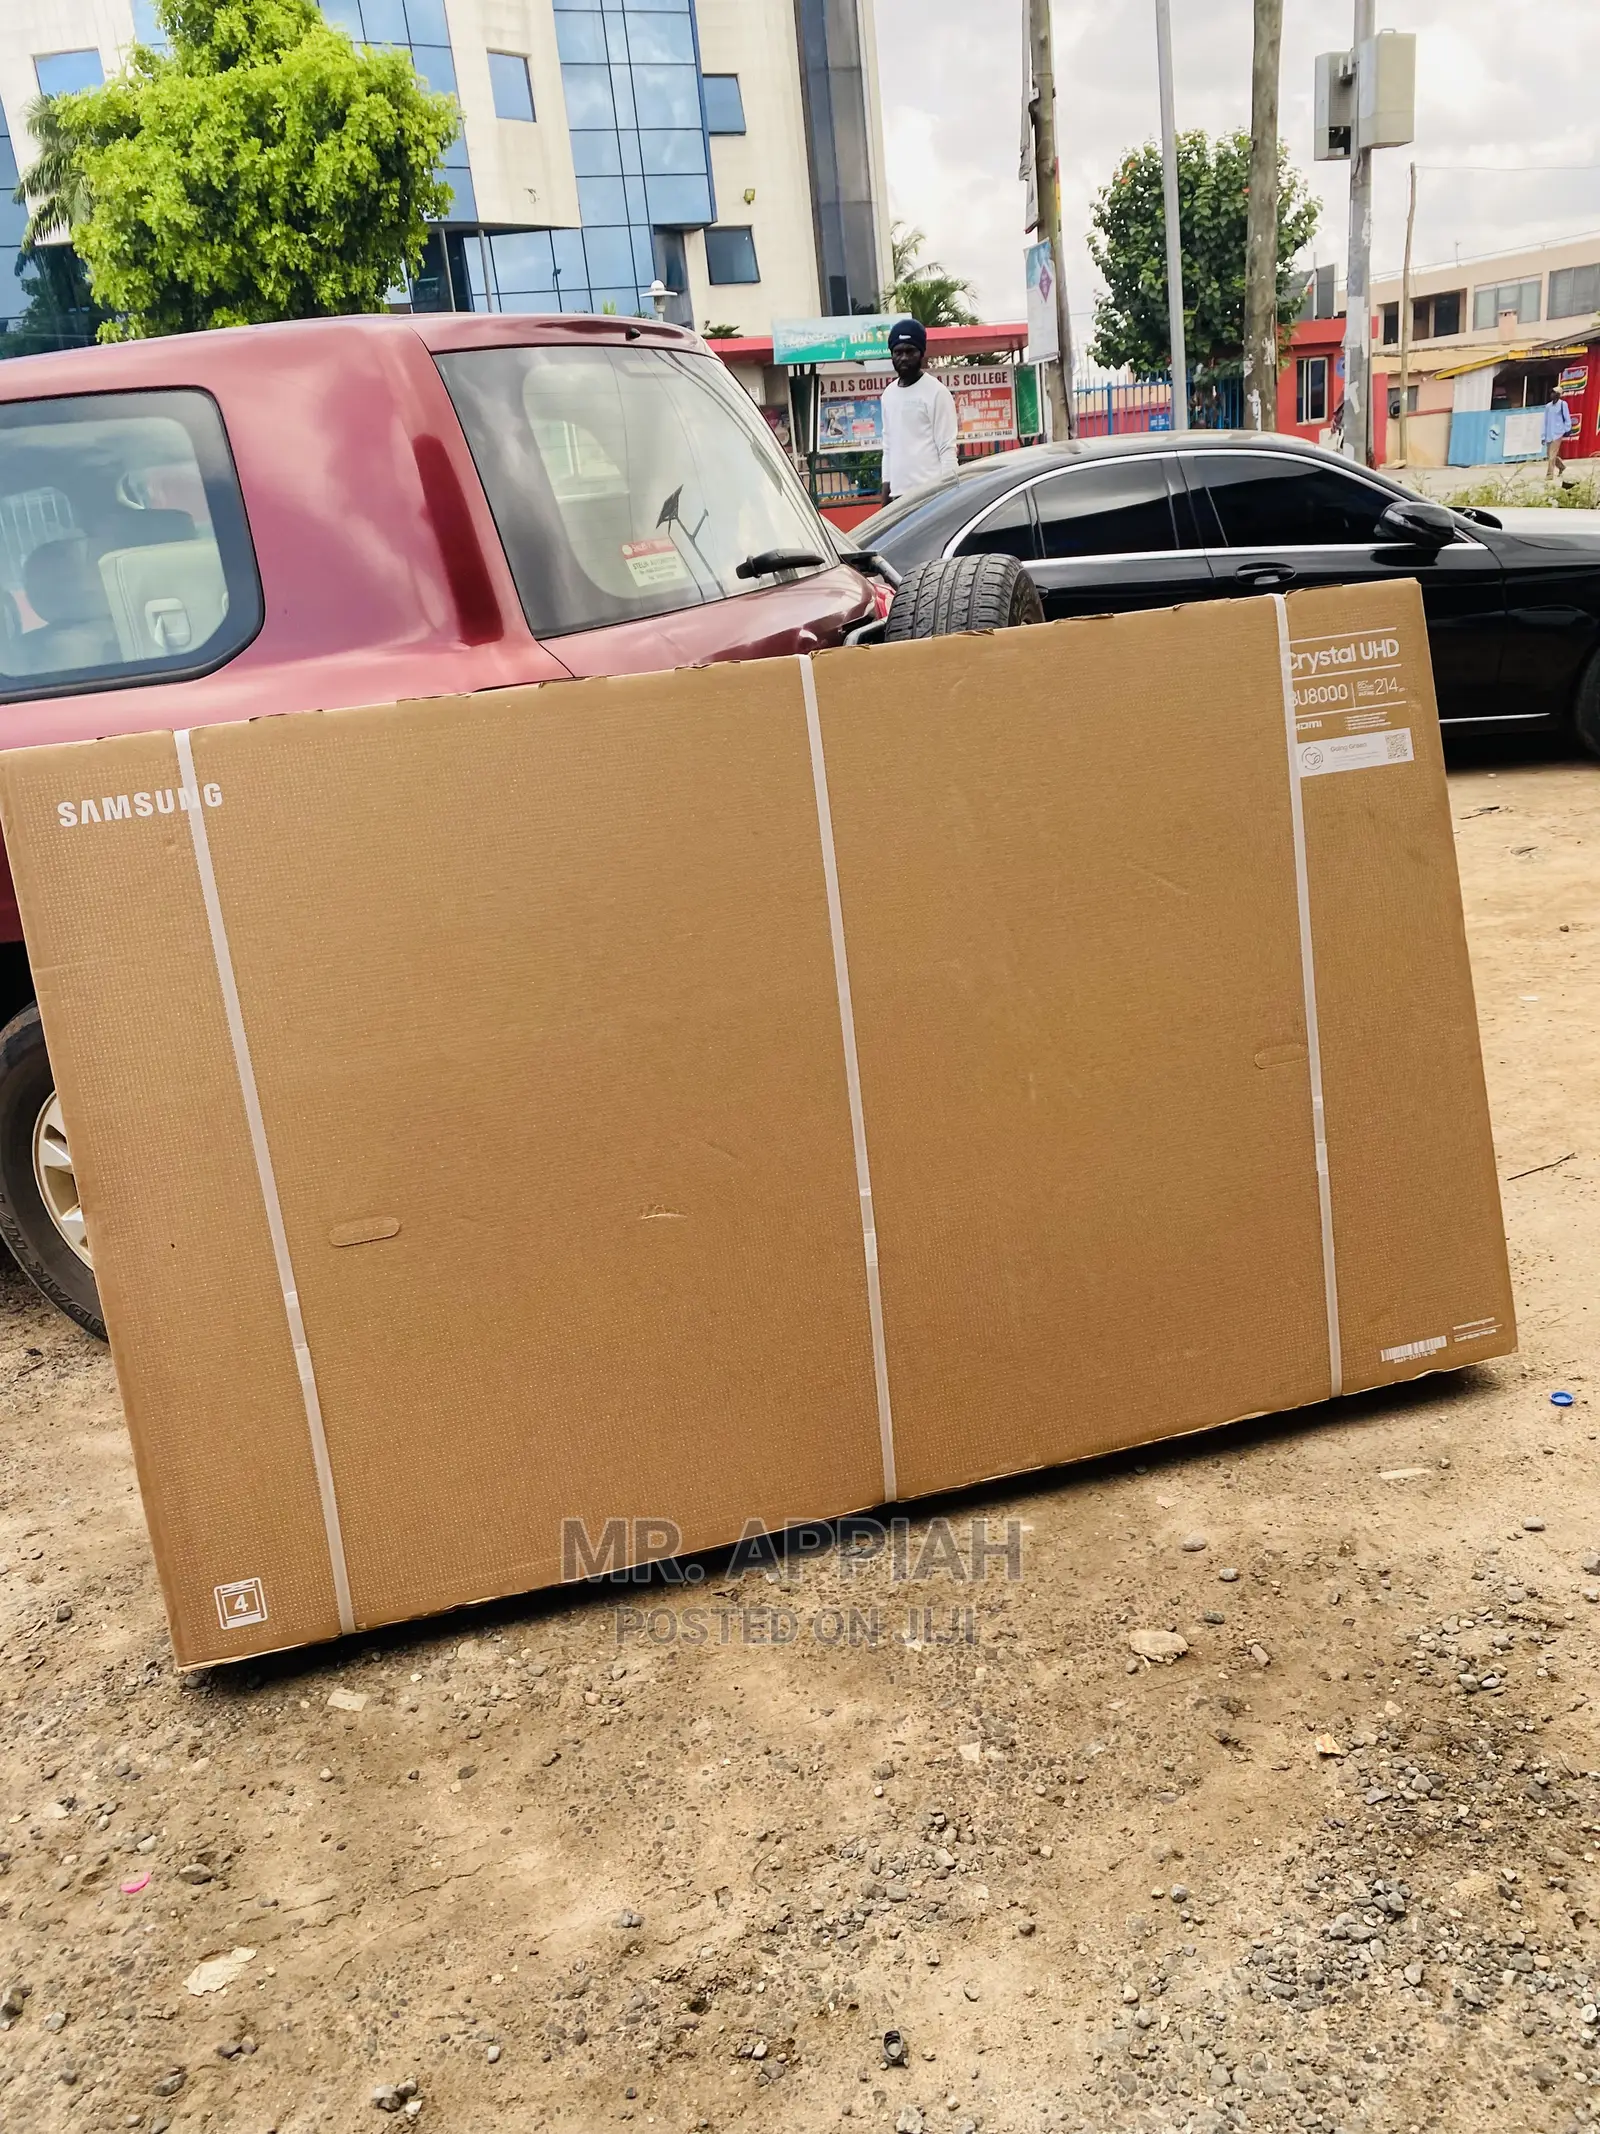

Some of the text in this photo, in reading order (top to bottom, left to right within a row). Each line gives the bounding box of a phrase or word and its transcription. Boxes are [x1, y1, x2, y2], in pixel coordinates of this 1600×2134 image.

[963, 371, 1008, 386] COLLEGE
[1284, 638, 1400, 674] Crystal UHD
[1288, 683, 1348, 707] BU8000
[1374, 676, 1399, 696] 214
[57, 782, 223, 828] SAMSUNG
[233, 1594, 249, 1612] 4
